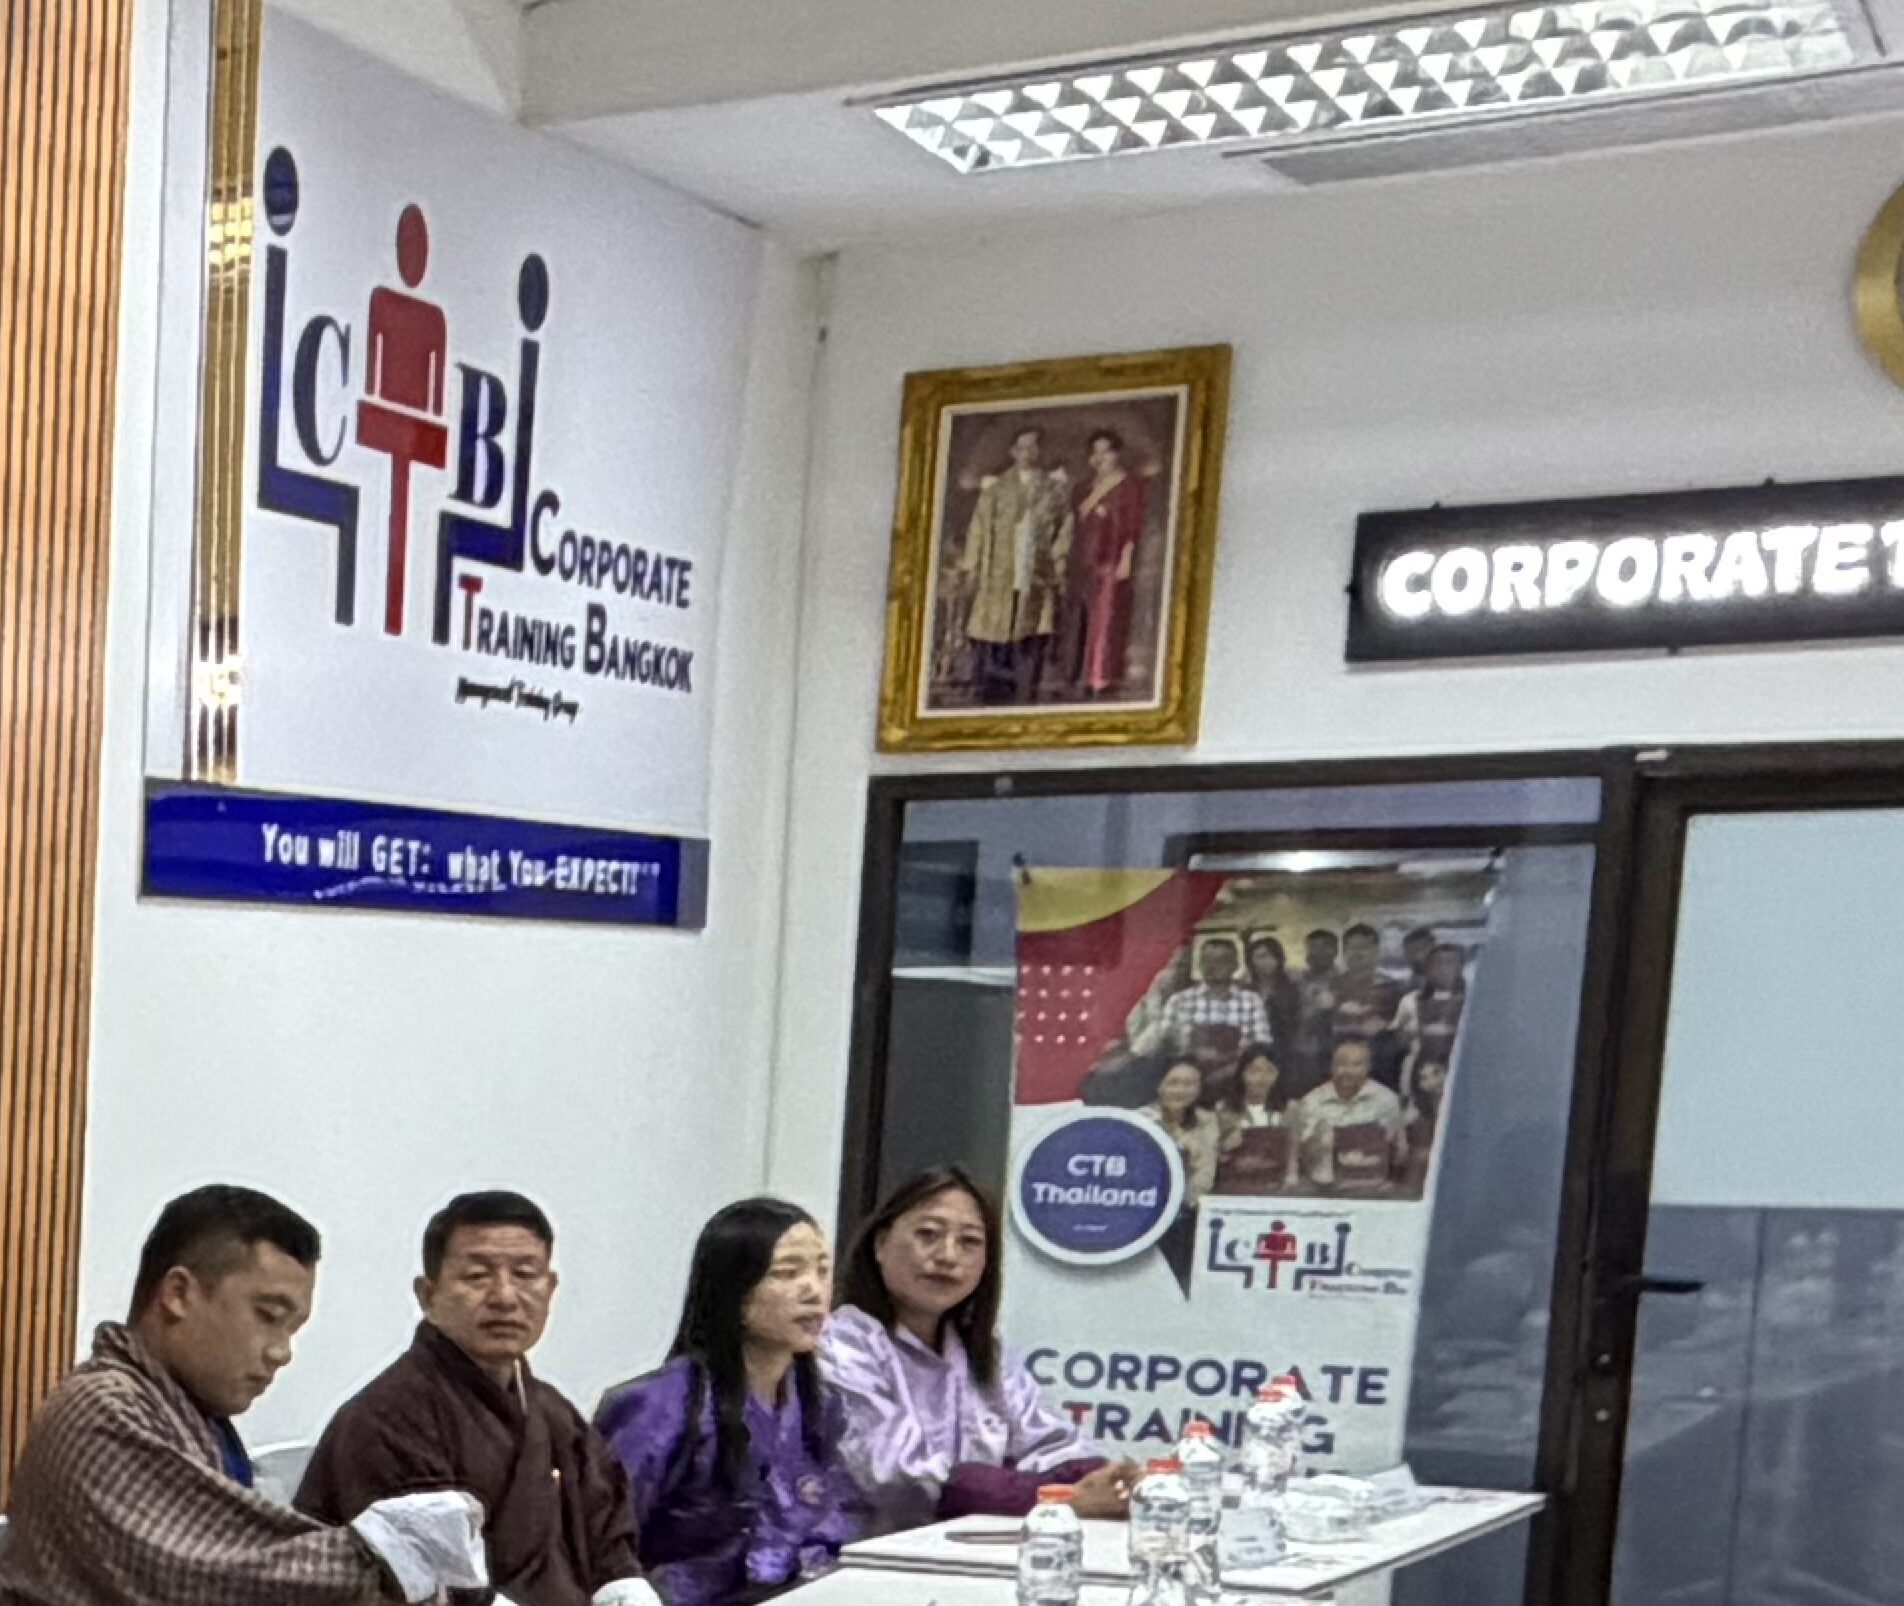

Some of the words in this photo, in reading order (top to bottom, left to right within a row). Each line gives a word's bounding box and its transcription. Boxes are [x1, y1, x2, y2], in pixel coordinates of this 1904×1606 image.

[530, 490, 693, 608] CORPORATE
[1382, 522, 1873, 617] CORPORATE
[458, 573, 576, 670] TRAINING
[584, 602, 693, 693] BANGKOK
[261, 823, 309, 866] You
[318, 830, 360, 870] will
[1031, 1181, 1158, 1208] Thailand
[1063, 1401, 1336, 1454] TRAINIG
